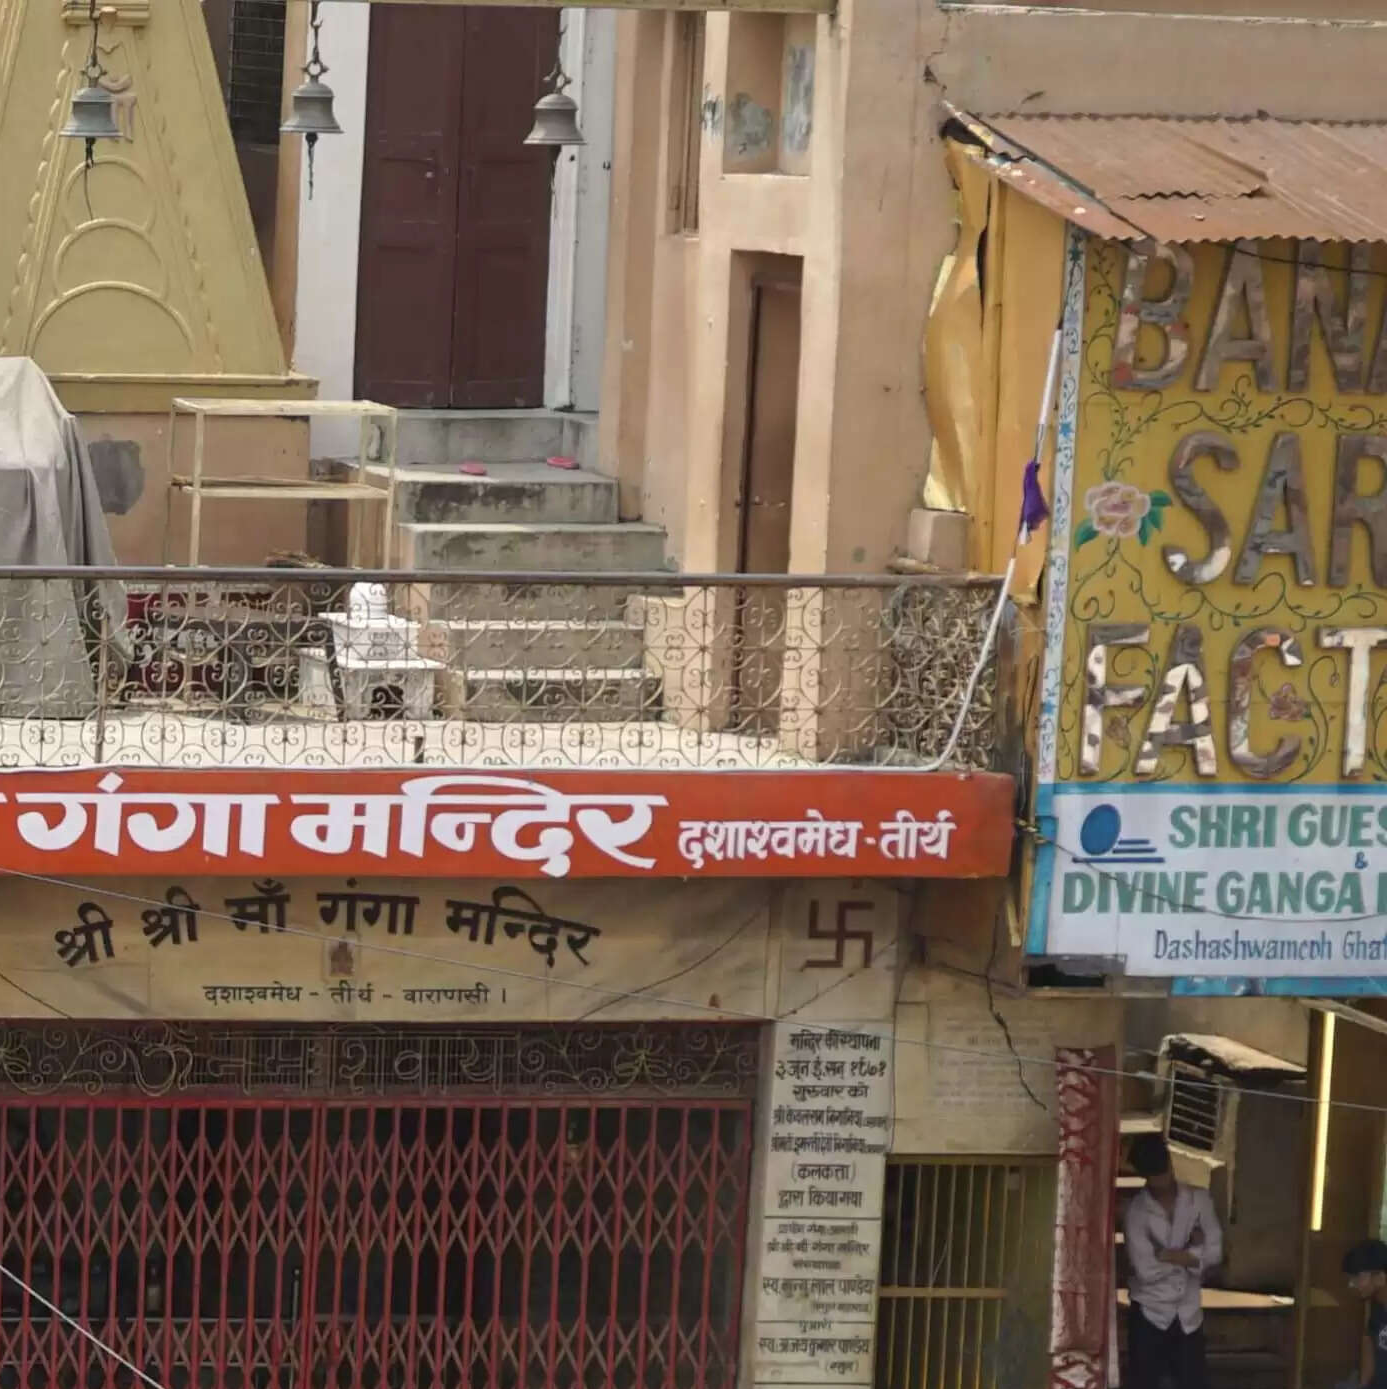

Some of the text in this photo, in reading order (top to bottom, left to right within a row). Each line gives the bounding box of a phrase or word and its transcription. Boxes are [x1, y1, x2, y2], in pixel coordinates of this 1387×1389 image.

[1113, 238, 1387, 392] BAN
[16, 771, 281, 857] गंगा
[290, 774, 669, 878] मन्दिर
[1168, 803, 1278, 849] SHRI
[55, 878, 602, 969] श्री श्री माँ गंगा मन्दिर
[1062, 871, 1208, 914] DIVINE
[1216, 871, 1365, 914] GANGA
[203, 981, 303, 1006] दशाश्वमेध
[329, 979, 375, 1005] तीर्थ
[402, 982, 491, 1006] वाराणसी
